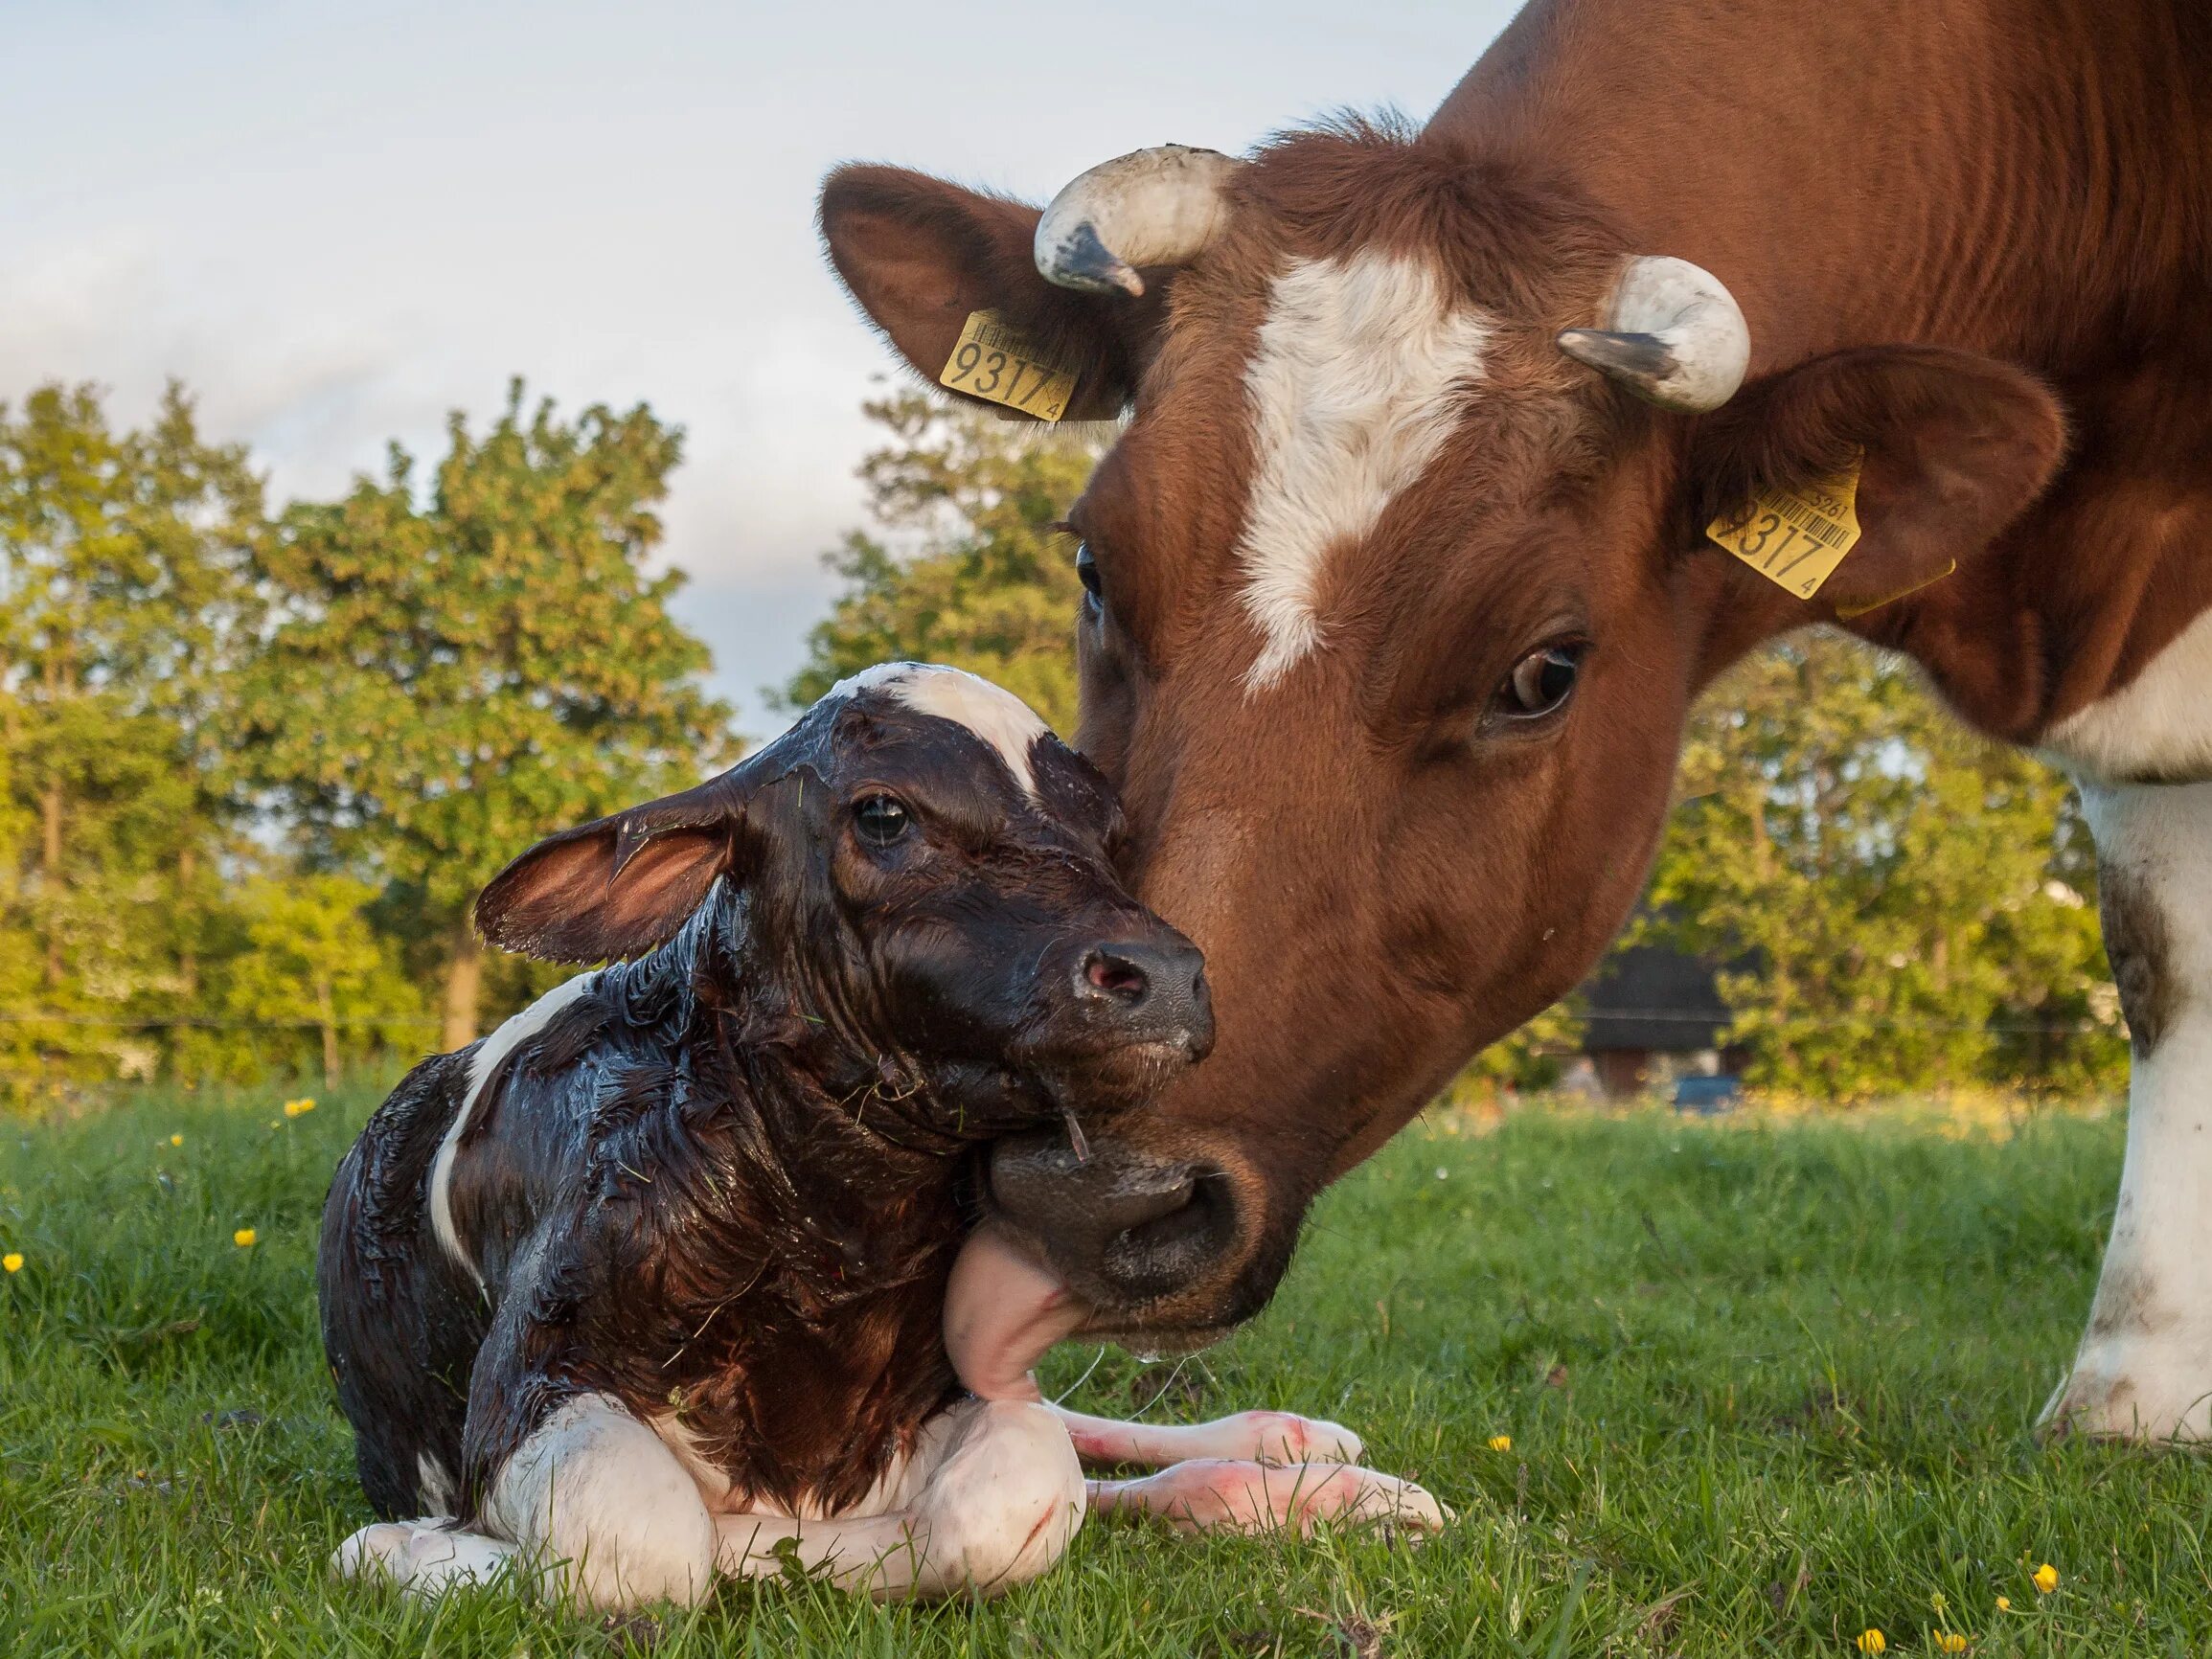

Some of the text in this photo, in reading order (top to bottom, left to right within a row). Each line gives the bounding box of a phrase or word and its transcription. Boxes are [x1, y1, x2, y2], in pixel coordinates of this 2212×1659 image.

[950, 342, 1057, 405] 9317
[1046, 402, 1060, 419] 4
[1801, 577, 1817, 594] 4
